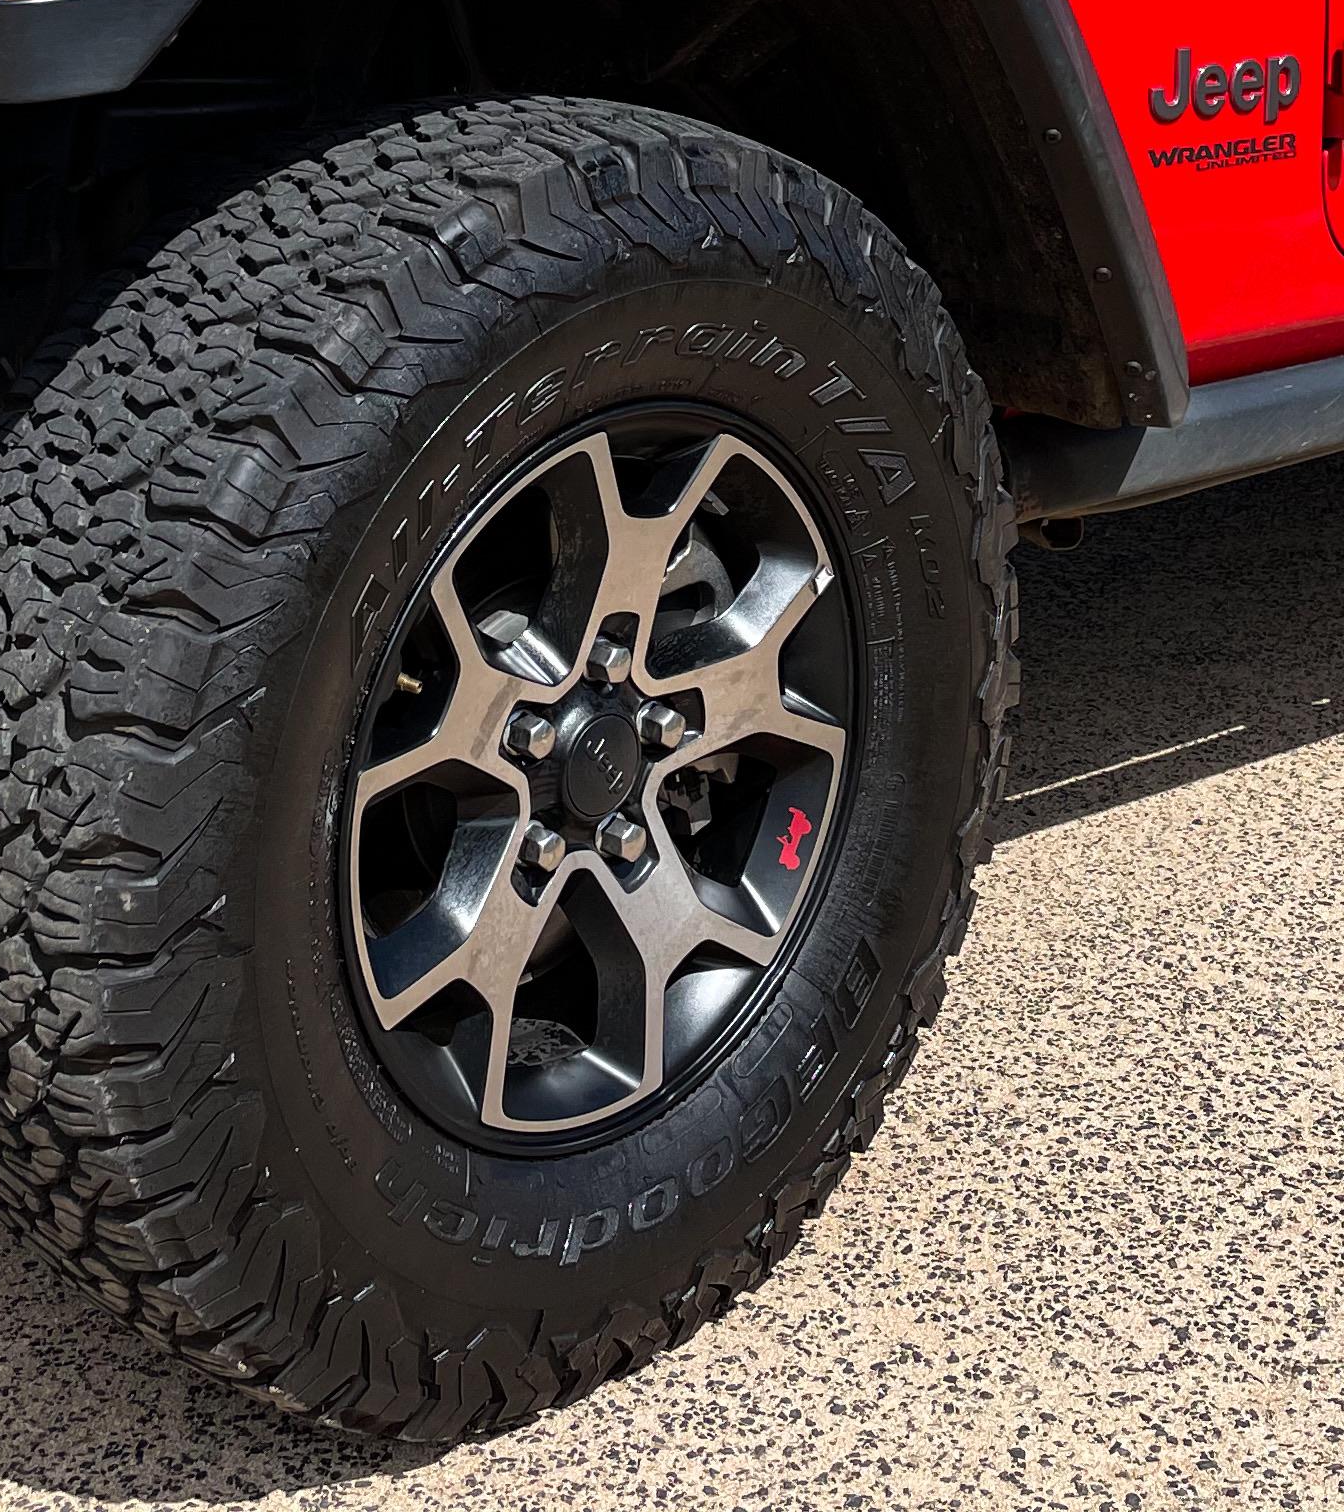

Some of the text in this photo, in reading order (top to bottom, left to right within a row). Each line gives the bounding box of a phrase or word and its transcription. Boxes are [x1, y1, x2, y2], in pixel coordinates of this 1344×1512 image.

[1148, 46, 1301, 126] Jeep
[1147, 133, 1297, 169] WRANGLER
[1195, 151, 1297, 172] UNLIMITED
[372, 936, 885, 1267] BFGoodrich
